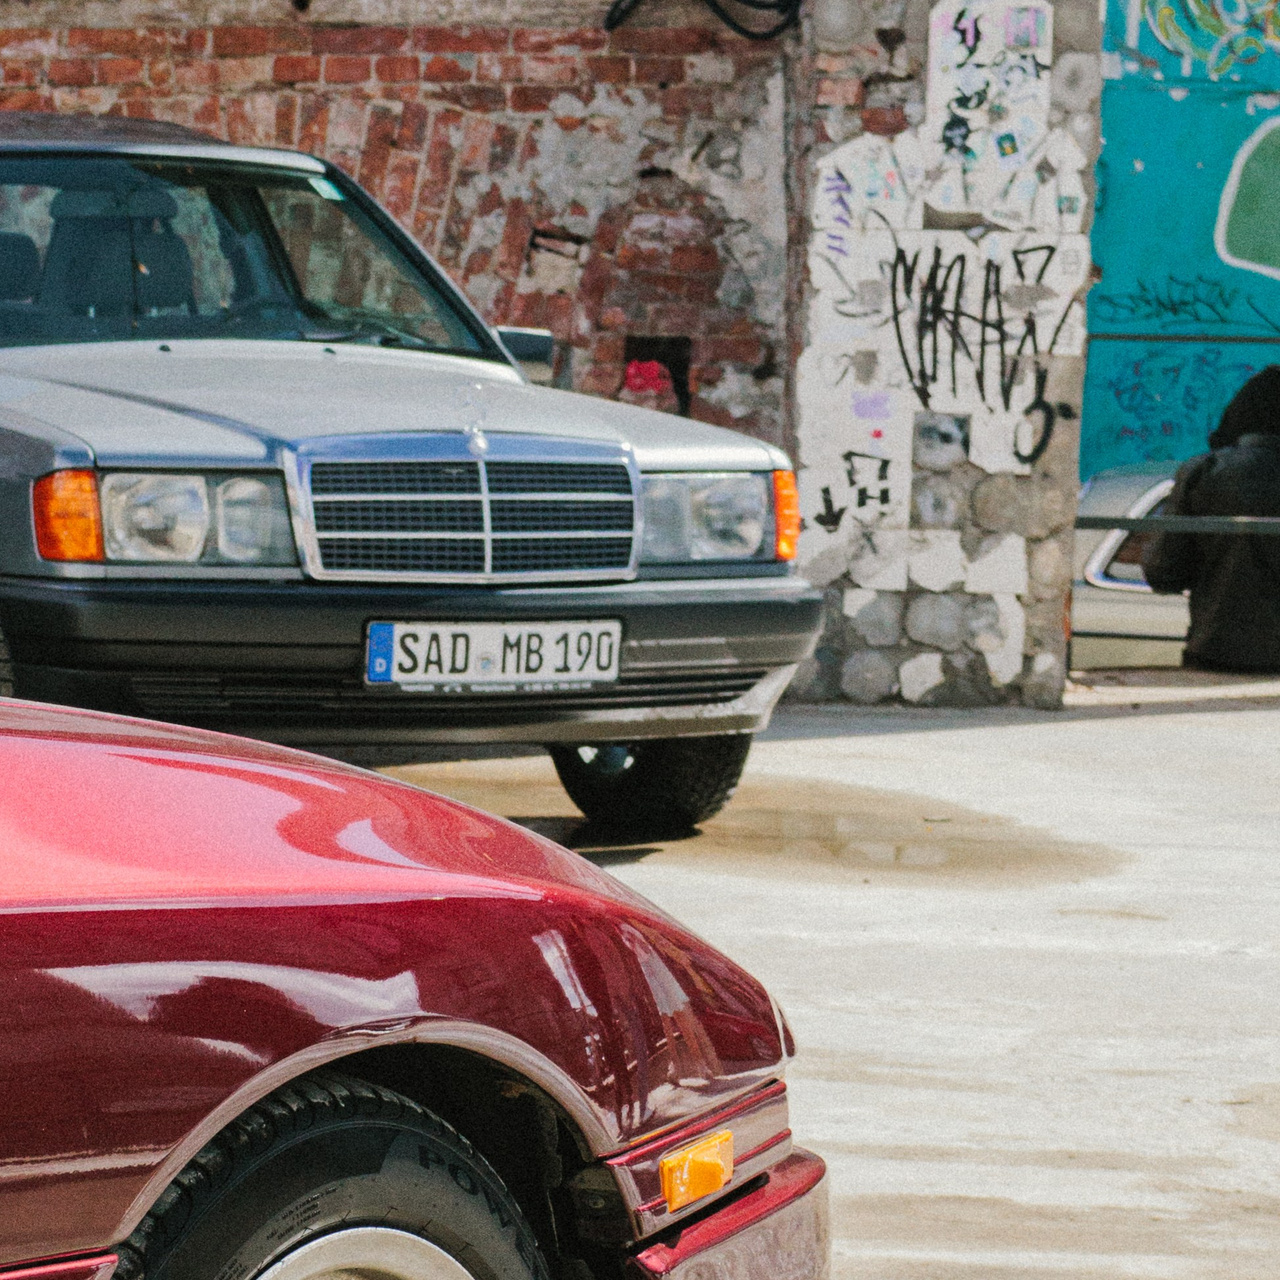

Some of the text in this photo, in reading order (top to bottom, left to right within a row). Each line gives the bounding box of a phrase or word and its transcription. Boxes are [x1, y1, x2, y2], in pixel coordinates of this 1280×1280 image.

[375, 658, 387, 673] D
[397, 630, 613, 674] SAD MB 190
